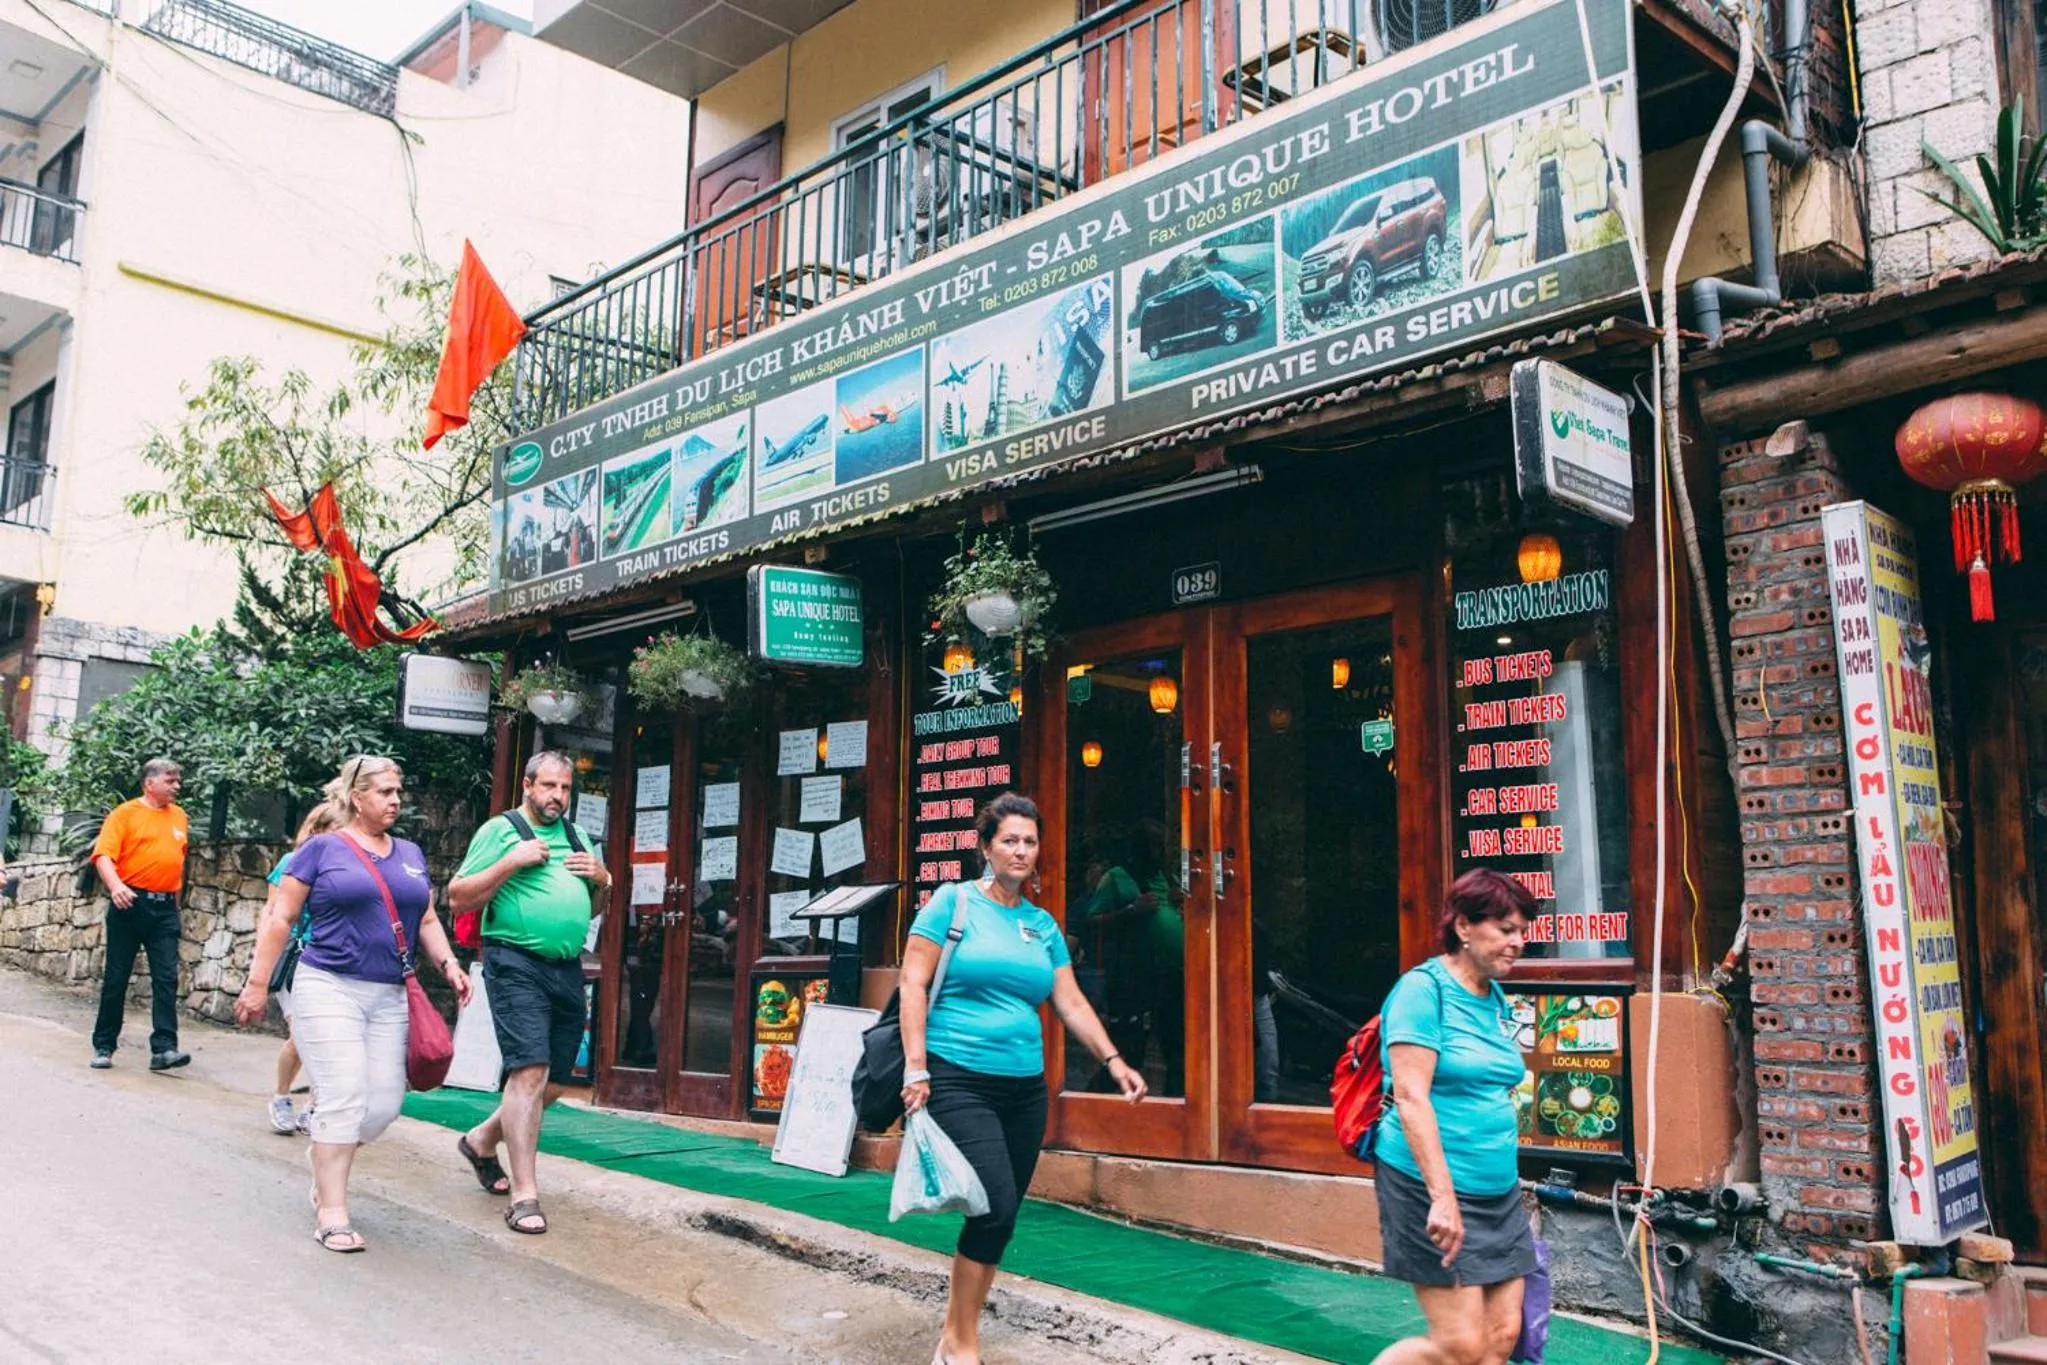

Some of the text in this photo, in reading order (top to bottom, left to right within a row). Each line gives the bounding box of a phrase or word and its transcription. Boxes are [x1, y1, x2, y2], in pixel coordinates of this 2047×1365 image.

[1148, 173, 1301, 248] Fax: 0203 872 007
[602, 393, 669, 438] TNHH
[675, 376, 713, 411] DU
[719, 347, 785, 393] LỊCH
[791, 298, 906, 366] KHÁNH
[914, 259, 998, 315] VIỆT
[1027, 208, 1132, 270] SAPA
[1144, 121, 1331, 224] UNIQUE
[1344, 43, 1536, 146] HOTEL
[977, 254, 1098, 313] Tel: 0203 872 008
[789, 319, 938, 386] www.sapauniquehotel.com
[1191, 271, 1560, 409] PRIVATE CAR SERVICE
[665, 417, 682, 433] 039
[944, 416, 1106, 483] VISA SERVICE
[770, 483, 891, 535] AIR TICKETS
[615, 529, 730, 578] TRAIN TICKETS
[1834, 528, 1861, 567] NHÀ
[529, 572, 584, 602] TICKETS
[1176, 569, 1217, 596] 039
[1835, 571, 1867, 607] HÀNG
[772, 599, 861, 623] SAPA UNIQUE HOTEL
[1455, 569, 1608, 630] TRANSPORTATION
[1464, 649, 1553, 687] BUS TICKETS
[1845, 650, 1874, 676] HOME
[949, 670, 981, 693] FREE
[943, 700, 1020, 732] INFORMATION
[1465, 692, 1567, 731] TRAIN TICKETS
[945, 739, 975, 761] GROUP
[976, 735, 1000, 758] TOUR
[1467, 738, 1552, 772] AIR TICKETS
[986, 763, 1011, 786] TOUR
[951, 797, 974, 819] TOUR
[1467, 783, 1559, 816] CAR SERVICE
[1469, 824, 1564, 857] VISA SERVICE
[938, 860, 961, 881] TOUR
[1556, 913, 1584, 941] FOR
[1588, 911, 1628, 941] RENT
[1552, 1056, 1611, 1069] LOCAL FOOD
